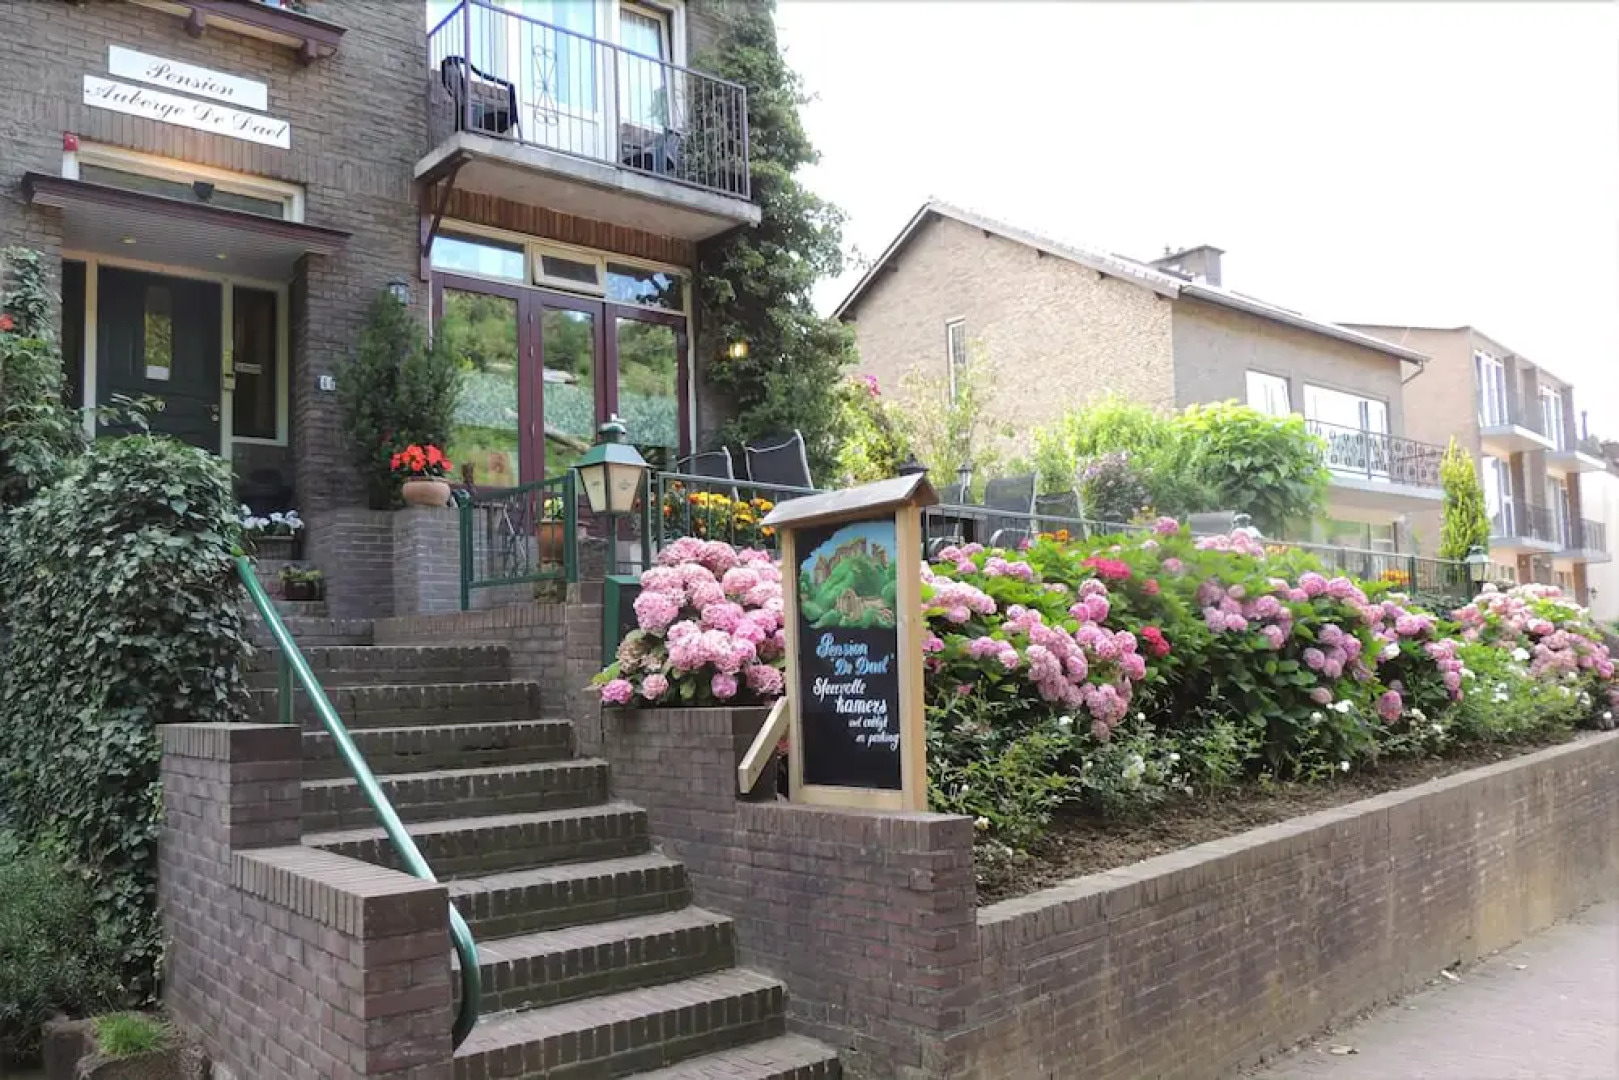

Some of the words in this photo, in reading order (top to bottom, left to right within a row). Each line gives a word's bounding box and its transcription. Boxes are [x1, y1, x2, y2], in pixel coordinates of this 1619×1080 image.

[145, 62, 235, 97] Pension
[85, 83, 185, 118] Auberge
[193, 103, 225, 124] De
[816, 632, 869, 658] Pension
[835, 695, 888, 715] kamers
[867, 731, 900, 751] parking
